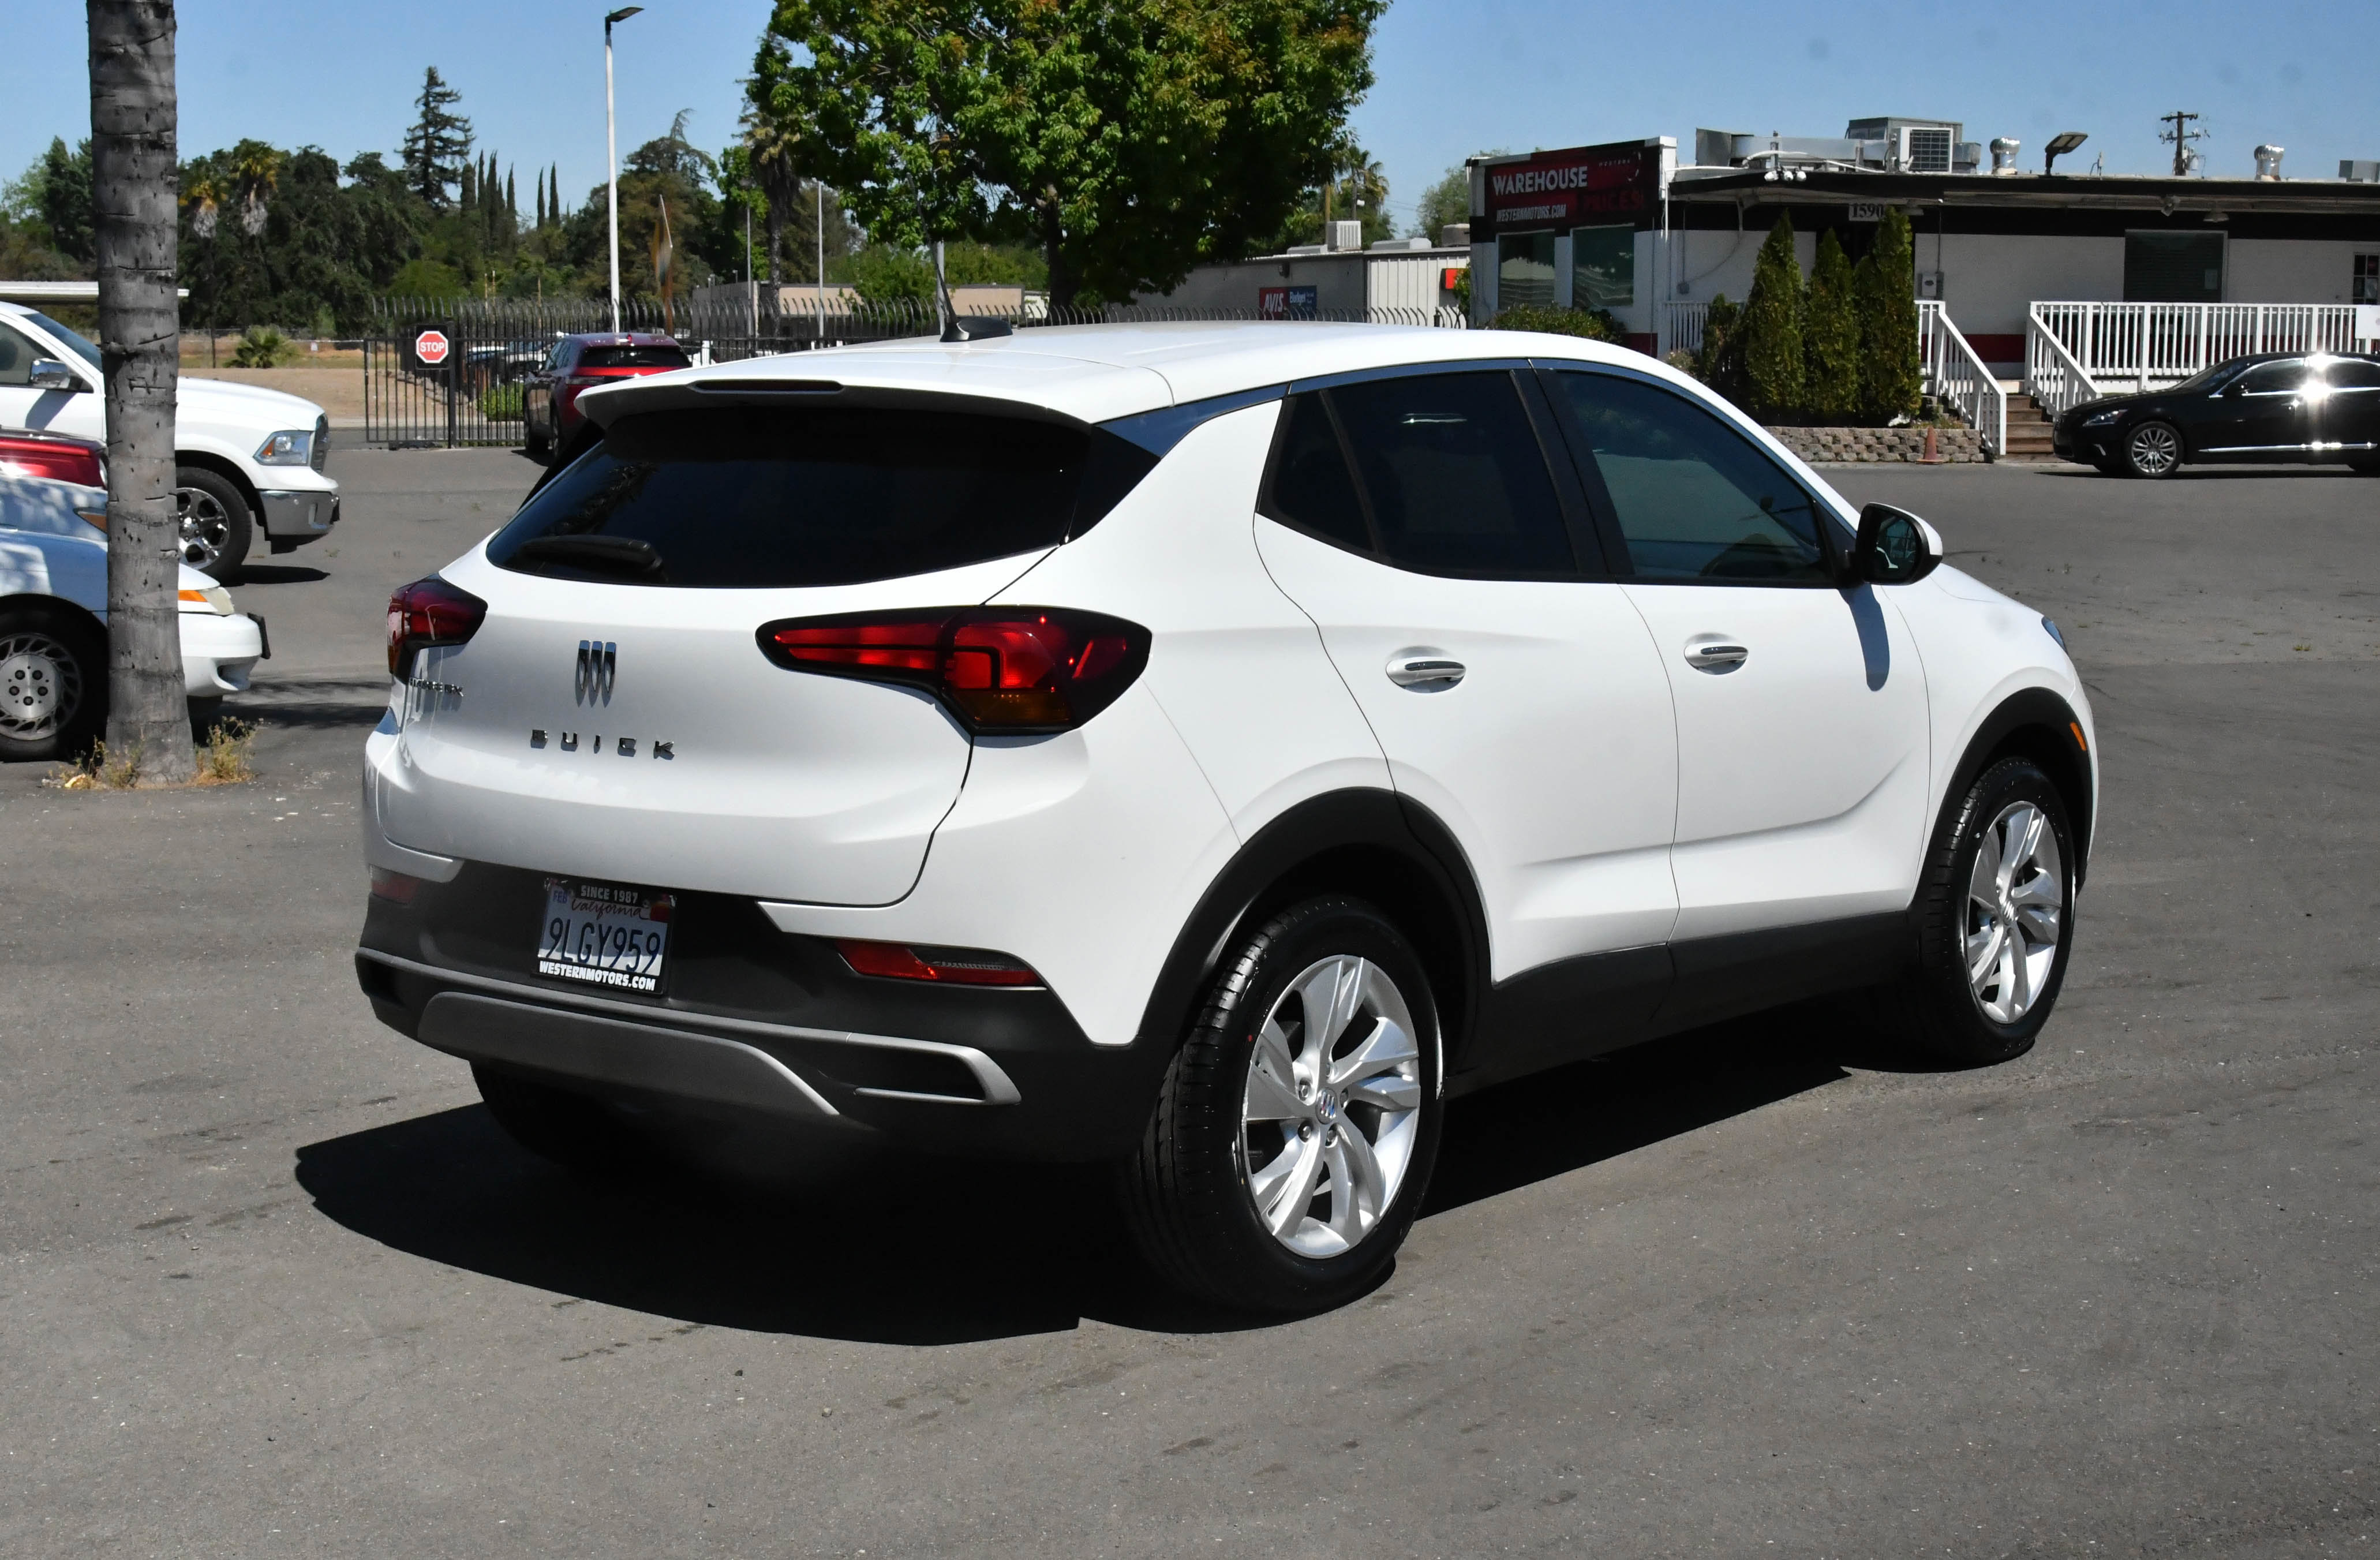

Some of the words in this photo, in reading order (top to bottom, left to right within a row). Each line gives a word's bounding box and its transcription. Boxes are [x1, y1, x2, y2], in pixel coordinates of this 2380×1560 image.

[1492, 166, 1588, 197] WAREHOUSE
[1496, 204, 1566, 222] WESTERNMOTORS.COM
[1850, 203, 1884, 218] 1590
[1264, 292, 1284, 313] AVIS
[420, 341, 445, 353] STOP
[531, 729, 675, 755] BUICK
[581, 885, 610, 900] SINCE
[613, 889, 639, 904] 1987
[546, 917, 661, 973] 9LGY959
[539, 960, 656, 992] WESTERNMOTORS.COM
